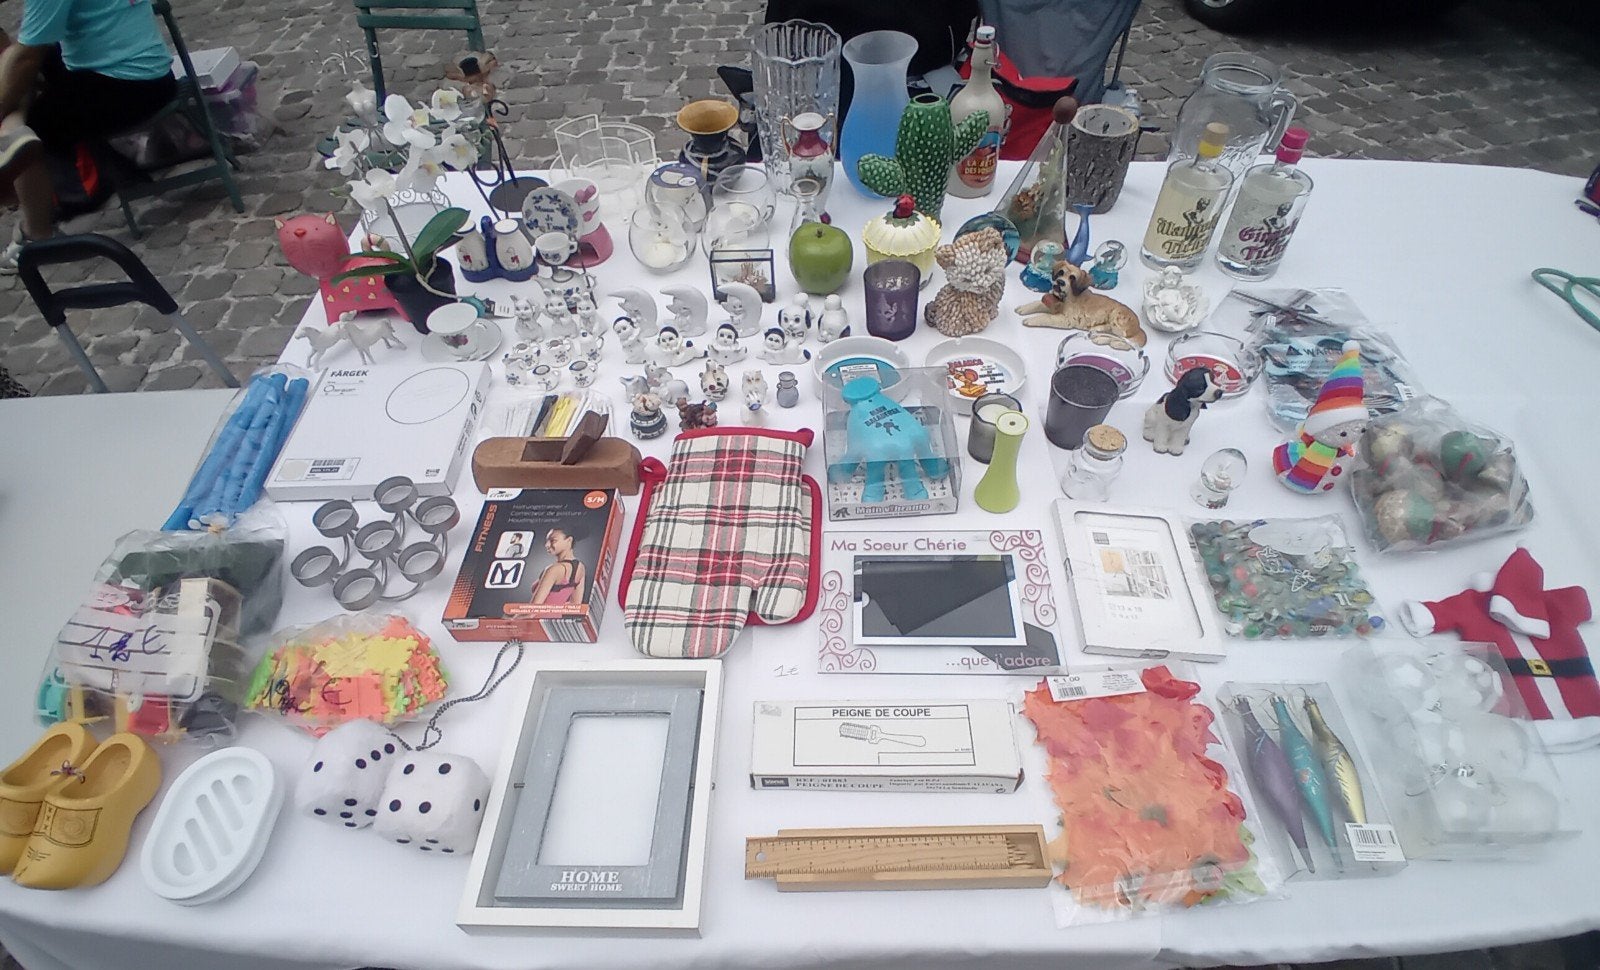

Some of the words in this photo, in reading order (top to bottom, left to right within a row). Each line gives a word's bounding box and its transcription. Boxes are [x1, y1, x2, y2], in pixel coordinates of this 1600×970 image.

[856, 506, 882, 514] Main
[474, 504, 498, 553] FITNESS
[831, 539, 857, 551] Ma
[863, 539, 908, 551] Soeur
[914, 538, 967, 551] Chérie
[946, 657, 990, 671] ...que
[995, 654, 1050, 669] j'adore
[832, 708, 871, 717] PEIGNE
[875, 708, 890, 717] DE
[893, 708, 931, 717] COUPE
[560, 870, 620, 883] HOME
[550, 883, 587, 891] SWEET
[590, 883, 623, 892] HOME
